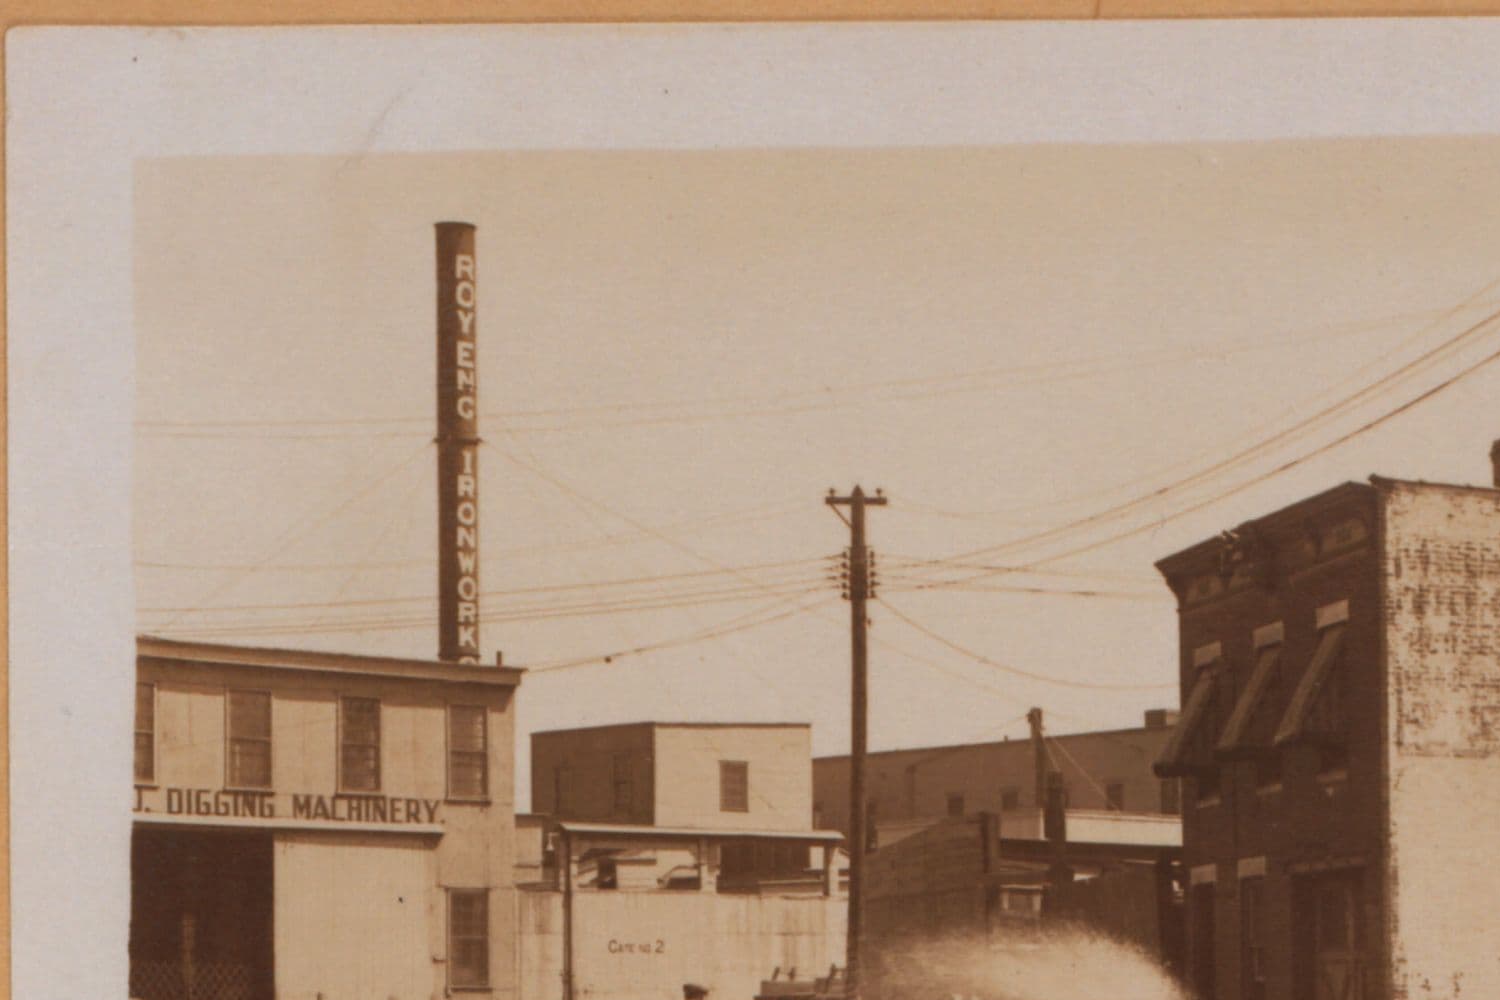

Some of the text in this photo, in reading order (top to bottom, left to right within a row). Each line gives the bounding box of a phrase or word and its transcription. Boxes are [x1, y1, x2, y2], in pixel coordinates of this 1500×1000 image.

[455, 254, 475, 335] ROY
[166, 787, 275, 819] DIGGING
[291, 793, 446, 825] MACHINERY.
[654, 939, 665, 954] 2
